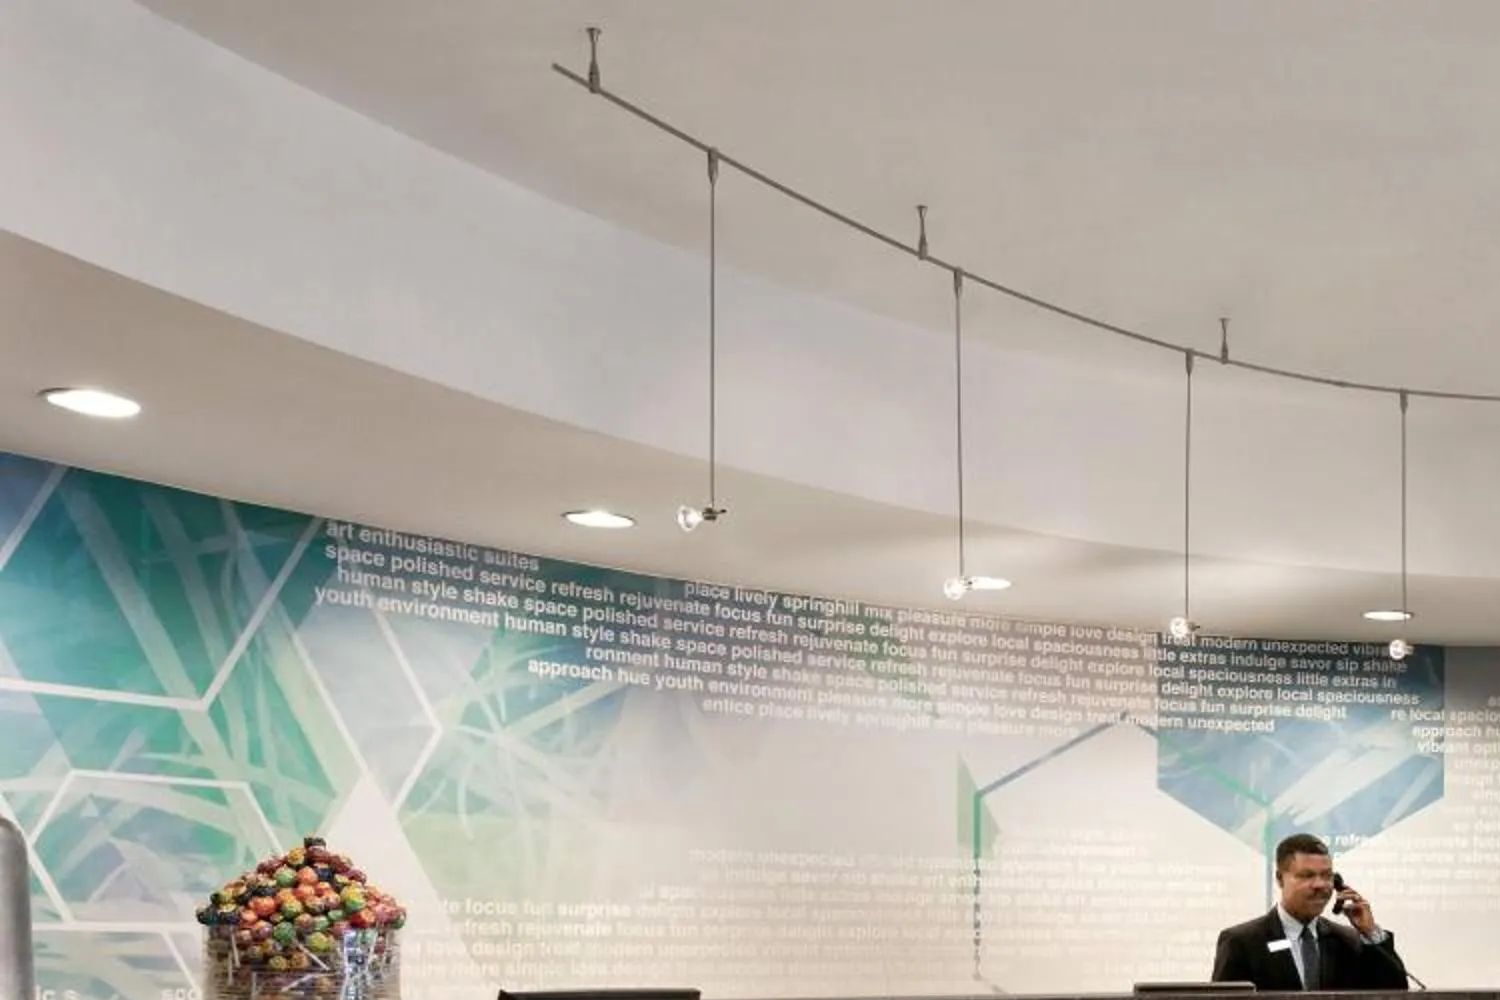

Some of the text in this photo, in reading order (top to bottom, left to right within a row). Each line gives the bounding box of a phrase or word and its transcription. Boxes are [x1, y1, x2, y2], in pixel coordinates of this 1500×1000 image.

[326, 524, 539, 571] art enthusiastic suites
[325, 546, 384, 569] space
[391, 556, 473, 581] polished
[480, 569, 545, 593] service
[552, 581, 614, 603] refresh
[620, 591, 710, 616] rejuvenate
[716, 602, 760, 623] focus
[767, 609, 792, 627] fun
[798, 616, 864, 635] surprise
[870, 620, 924, 642] delight
[929, 629, 987, 647] explore
[992, 633, 1029, 651] local
[1034, 640, 1139, 658] spaciousness
[1144, 644, 1174, 663] little
[1180, 651, 1226, 665] extras
[1232, 652, 1285, 671] indulge
[1291, 657, 1330, 670] savor
[1336, 657, 1358, 674] sip
[338, 567, 404, 591] human
[412, 579, 458, 600] style
[464, 585, 518, 608] shake
[524, 597, 576, 617] space
[583, 605, 658, 627] polished
[663, 616, 724, 637] service
[730, 624, 787, 645] refresh
[794, 633, 879, 653] rejuvenate
[884, 639, 926, 658] focus
[932, 644, 956, 661] fun
[962, 650, 1026, 668] surprise
[1031, 652, 1082, 673] delight
[1088, 659, 1144, 677] explore
[1150, 662, 1183, 678] local
[1190, 667, 1291, 684] spaciousness
[1297, 670, 1327, 685] little
[1332, 673, 1378, 688] extras
[685, 582, 729, 601] place
[735, 585, 776, 611] lively
[783, 597, 858, 617] springhill
[866, 603, 892, 618] mix
[898, 604, 965, 625] pleasure
[1071, 623, 1101, 640] love
[1108, 626, 1156, 647] design
[1202, 635, 1256, 651] modern
[1263, 640, 1348, 657] unexpected
[316, 589, 372, 608] youth
[377, 596, 498, 627] environment
[505, 612, 566, 636] human
[572, 623, 614, 644] style
[620, 628, 671, 648] shake
[677, 637, 726, 655] space
[732, 643, 802, 664] polished
[808, 653, 866, 671] service
[871, 657, 926, 675] refresh
[932, 662, 1013, 682] rejuvenate
[1018, 667, 1060, 686] focus
[1066, 671, 1090, 688] fun
[1162, 678, 1212, 698] delight
[1218, 683, 1272, 701] explore
[1278, 685, 1312, 701] local
[1317, 689, 1419, 706] spaciousness
[528, 660, 612, 681] approach
[618, 666, 649, 685] hue
[656, 673, 703, 690] youth
[708, 678, 811, 701] environment
[1188, 716, 1274, 733] unexpected
[664, 651, 722, 673] human
[728, 661, 766, 681] style
[878, 674, 946, 695] polished
[1155, 694, 1197, 710] focus
[1202, 696, 1226, 712] fun
[1230, 701, 1291, 718] surprise
[1296, 703, 1346, 721] delight
[703, 698, 802, 719] entice place
[1410, 707, 1444, 721] local
[1413, 723, 1481, 740] approach
